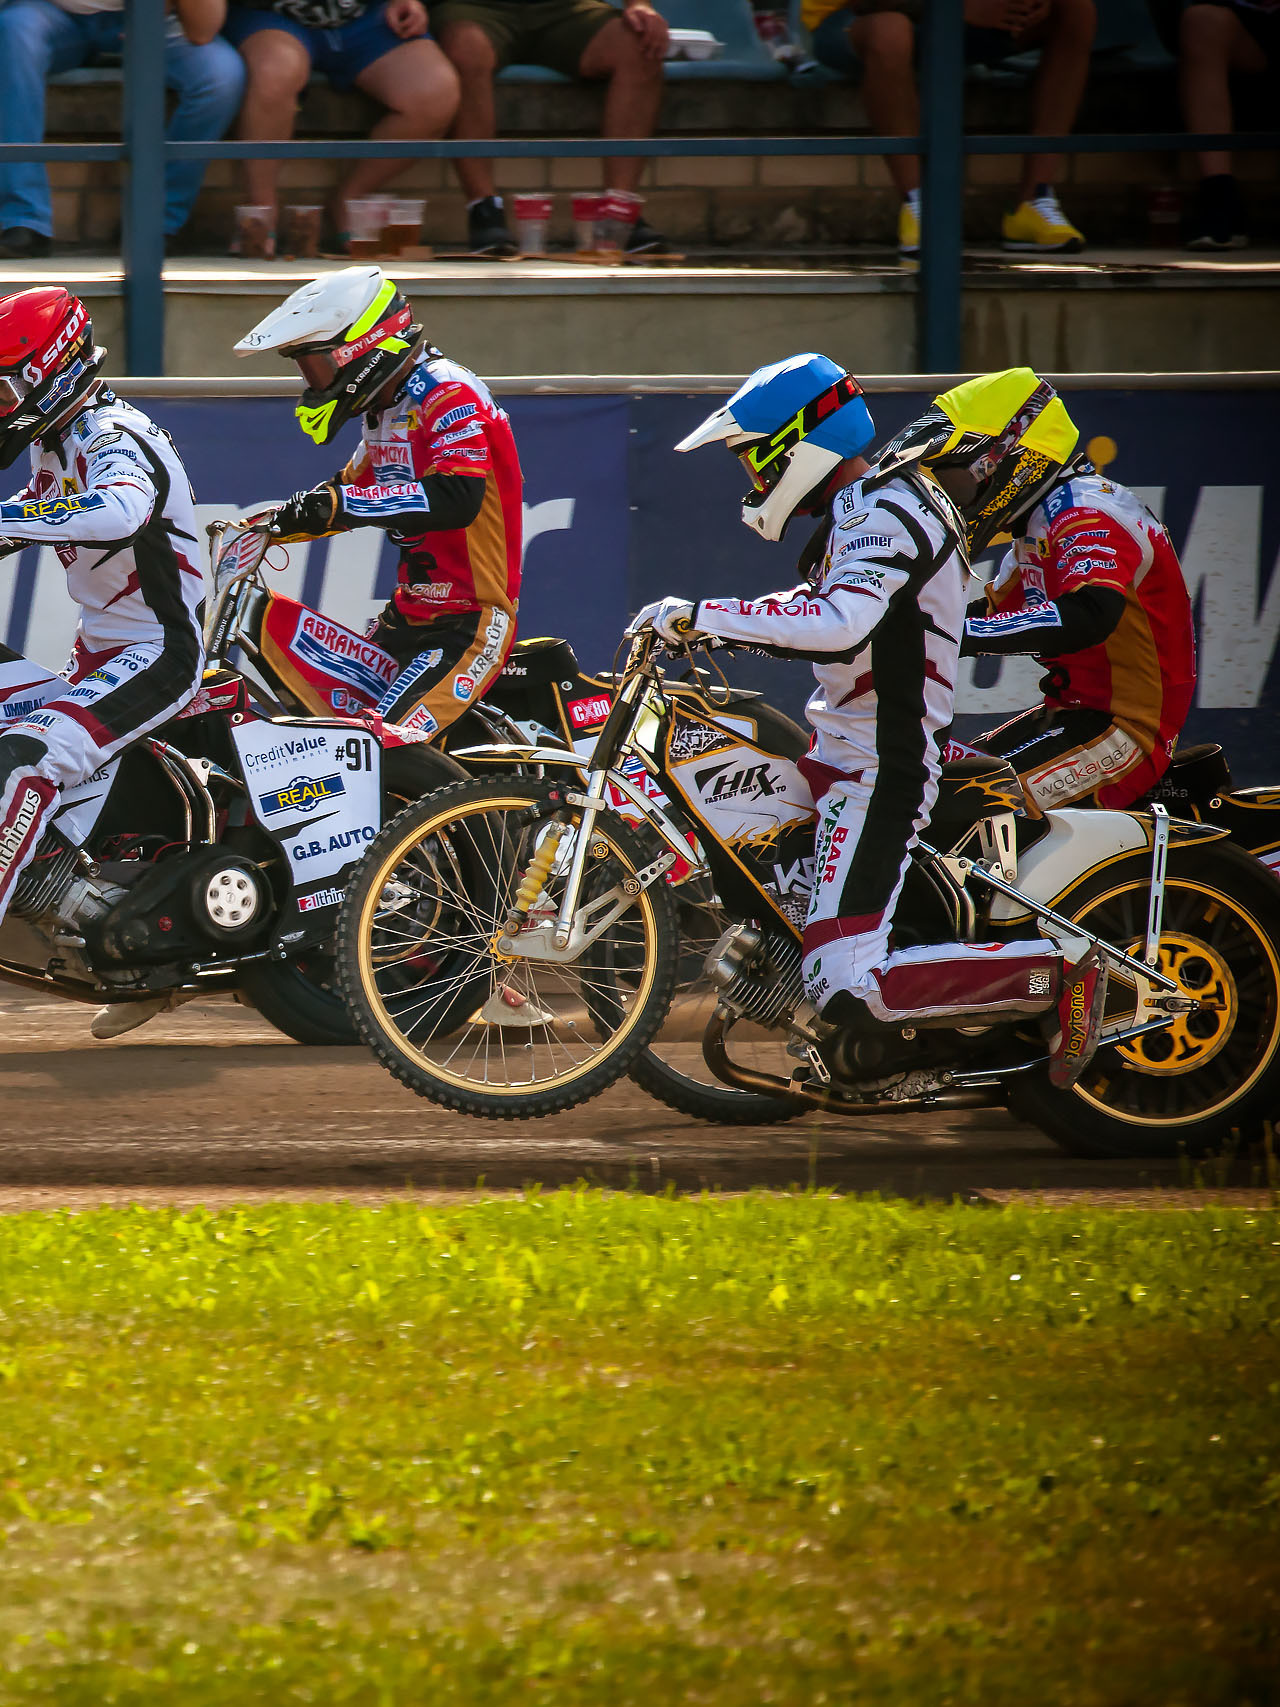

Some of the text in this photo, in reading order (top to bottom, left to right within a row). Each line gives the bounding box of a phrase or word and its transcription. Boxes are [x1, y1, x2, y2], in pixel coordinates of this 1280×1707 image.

[365, 328, 386, 344] LINE
[23, 498, 88, 518] REALL
[303, 616, 399, 683] ABRAMCZYK
[573, 699, 610, 723] CX80
[245, 736, 372, 772] CreditValue #91
[277, 781, 332, 807] REALL
[704, 783, 787, 805] FASTEST WAY TO
[292, 826, 376, 861] G.B. AUTO
[822, 826, 849, 884] BAR
